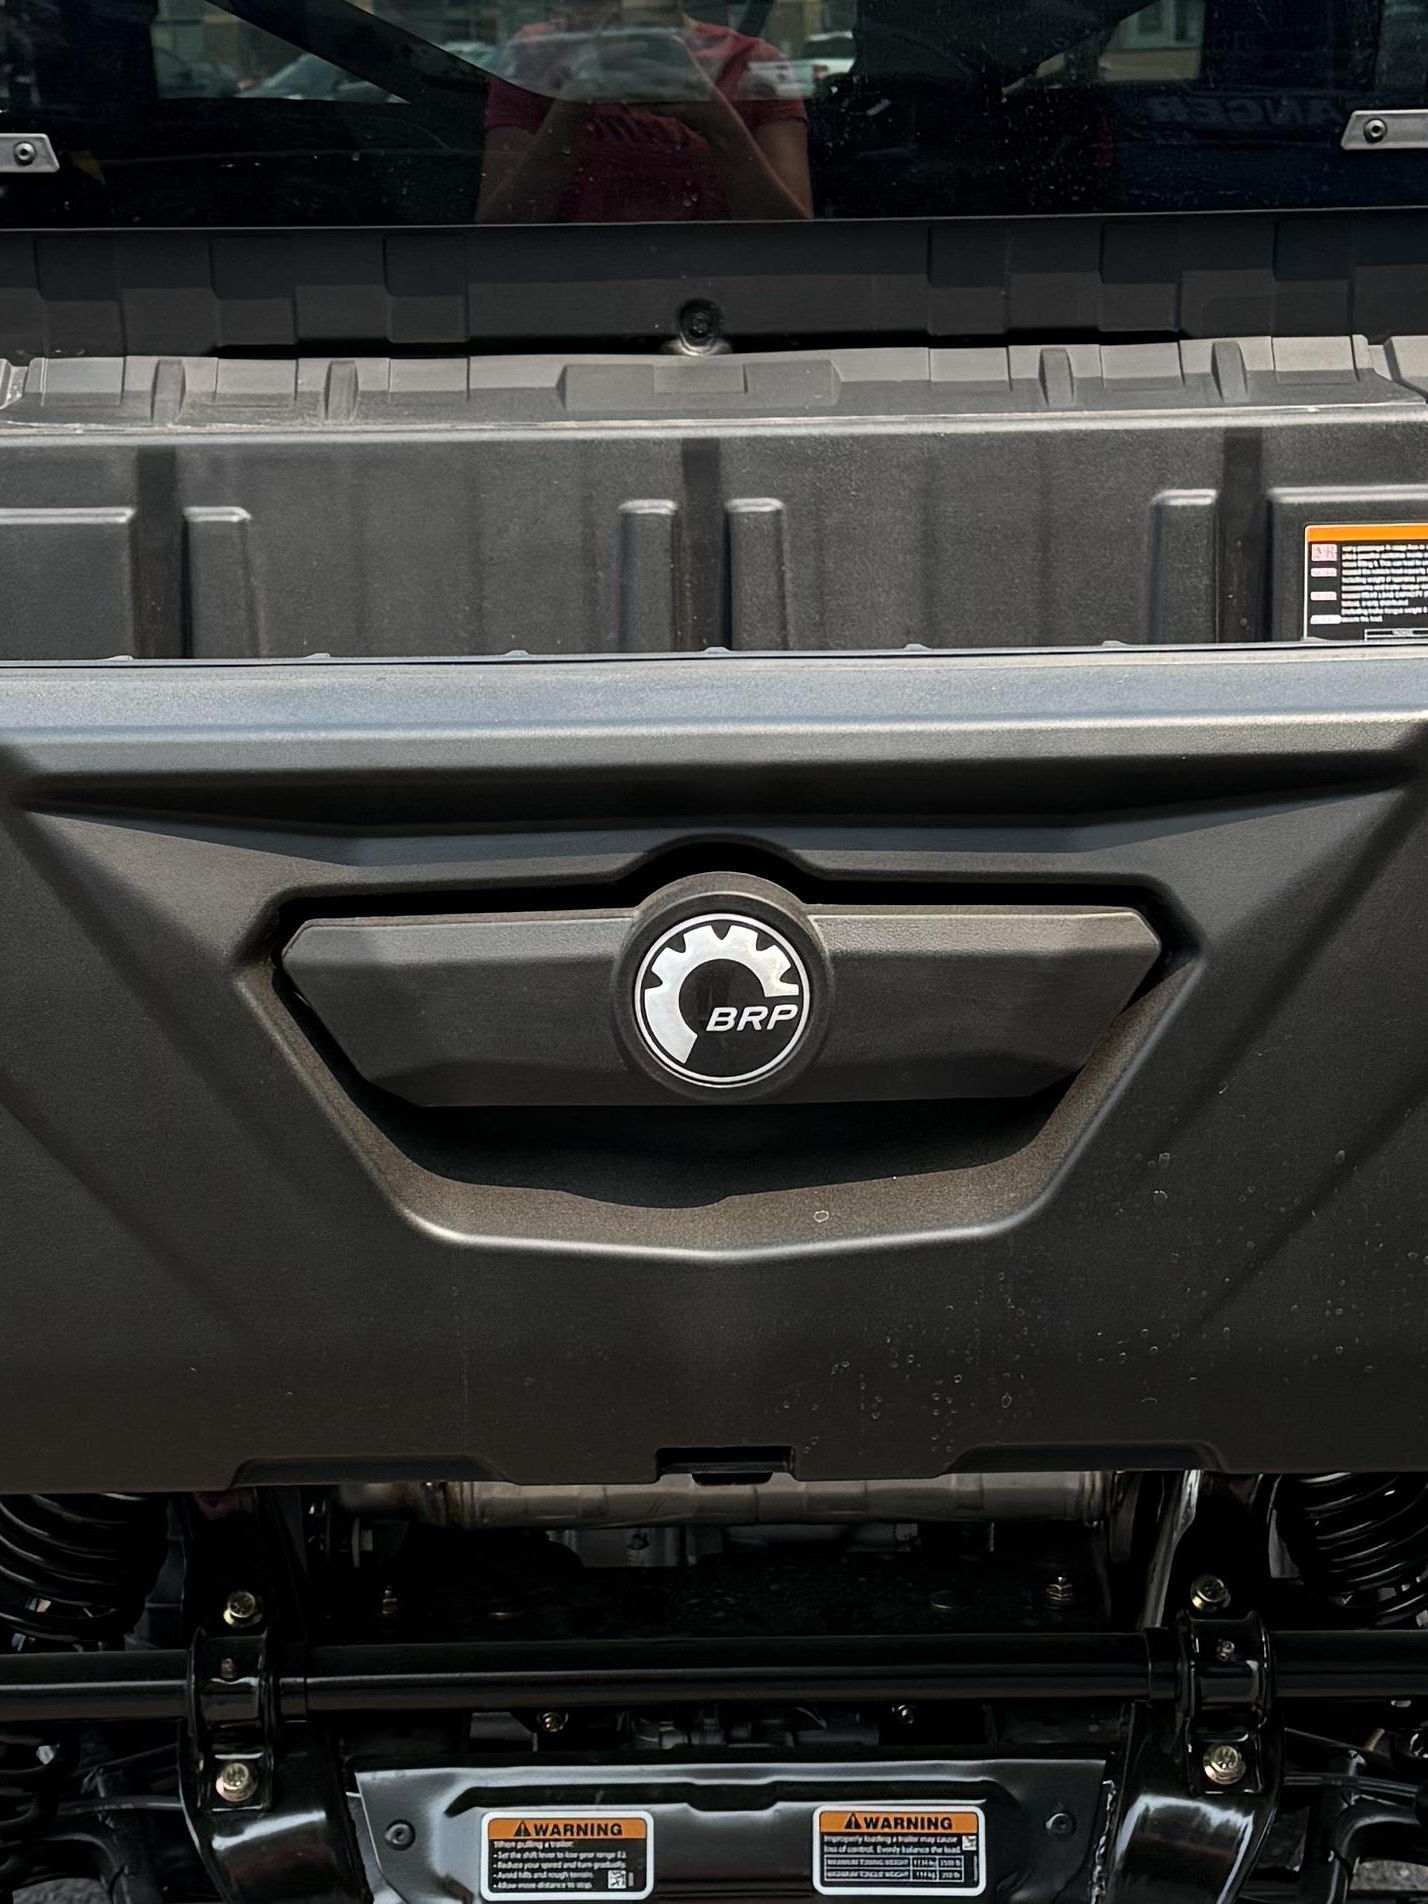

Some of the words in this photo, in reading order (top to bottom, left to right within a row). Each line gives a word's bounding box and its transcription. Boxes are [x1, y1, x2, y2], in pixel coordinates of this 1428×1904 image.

[706, 1004, 799, 1032] BRP
[533, 1822, 623, 1837] WARNING
[863, 1816, 953, 1830] WARNING
